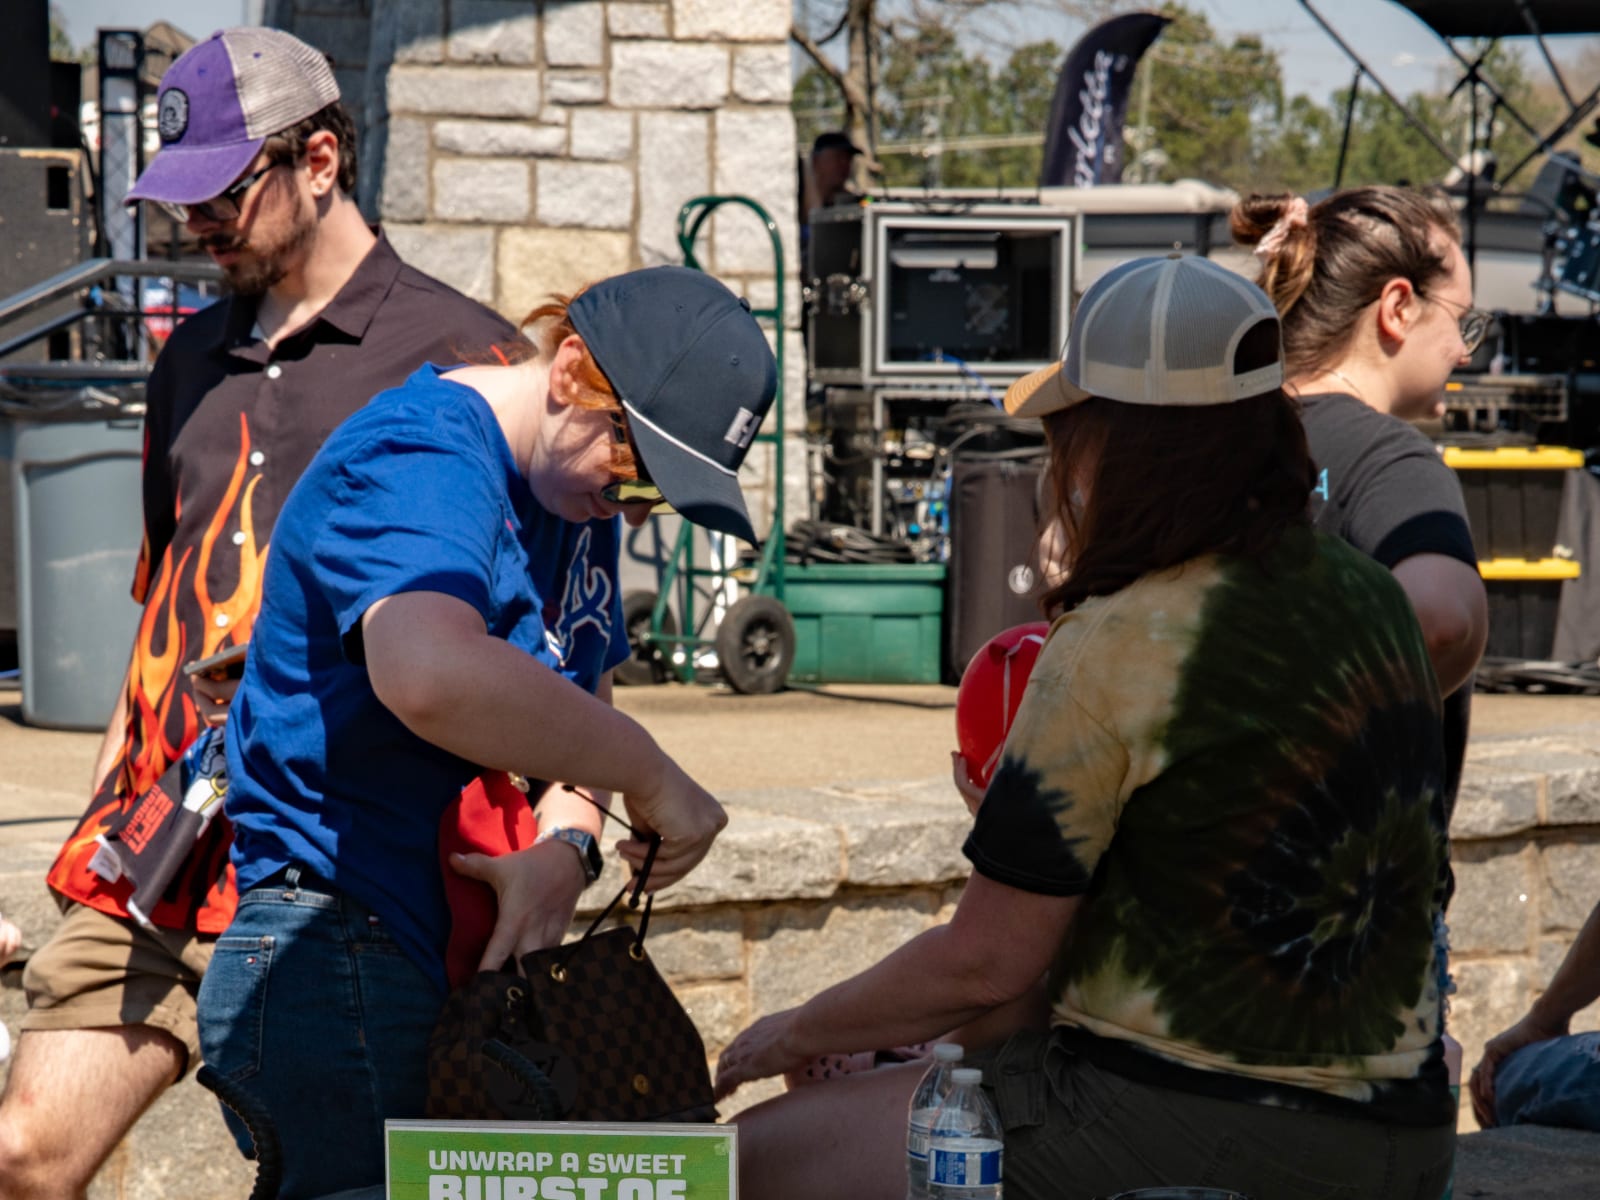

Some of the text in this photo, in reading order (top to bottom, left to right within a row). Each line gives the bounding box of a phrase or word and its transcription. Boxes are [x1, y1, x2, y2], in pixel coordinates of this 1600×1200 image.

[429, 1150, 686, 1174] UNWRAP A SWEET
